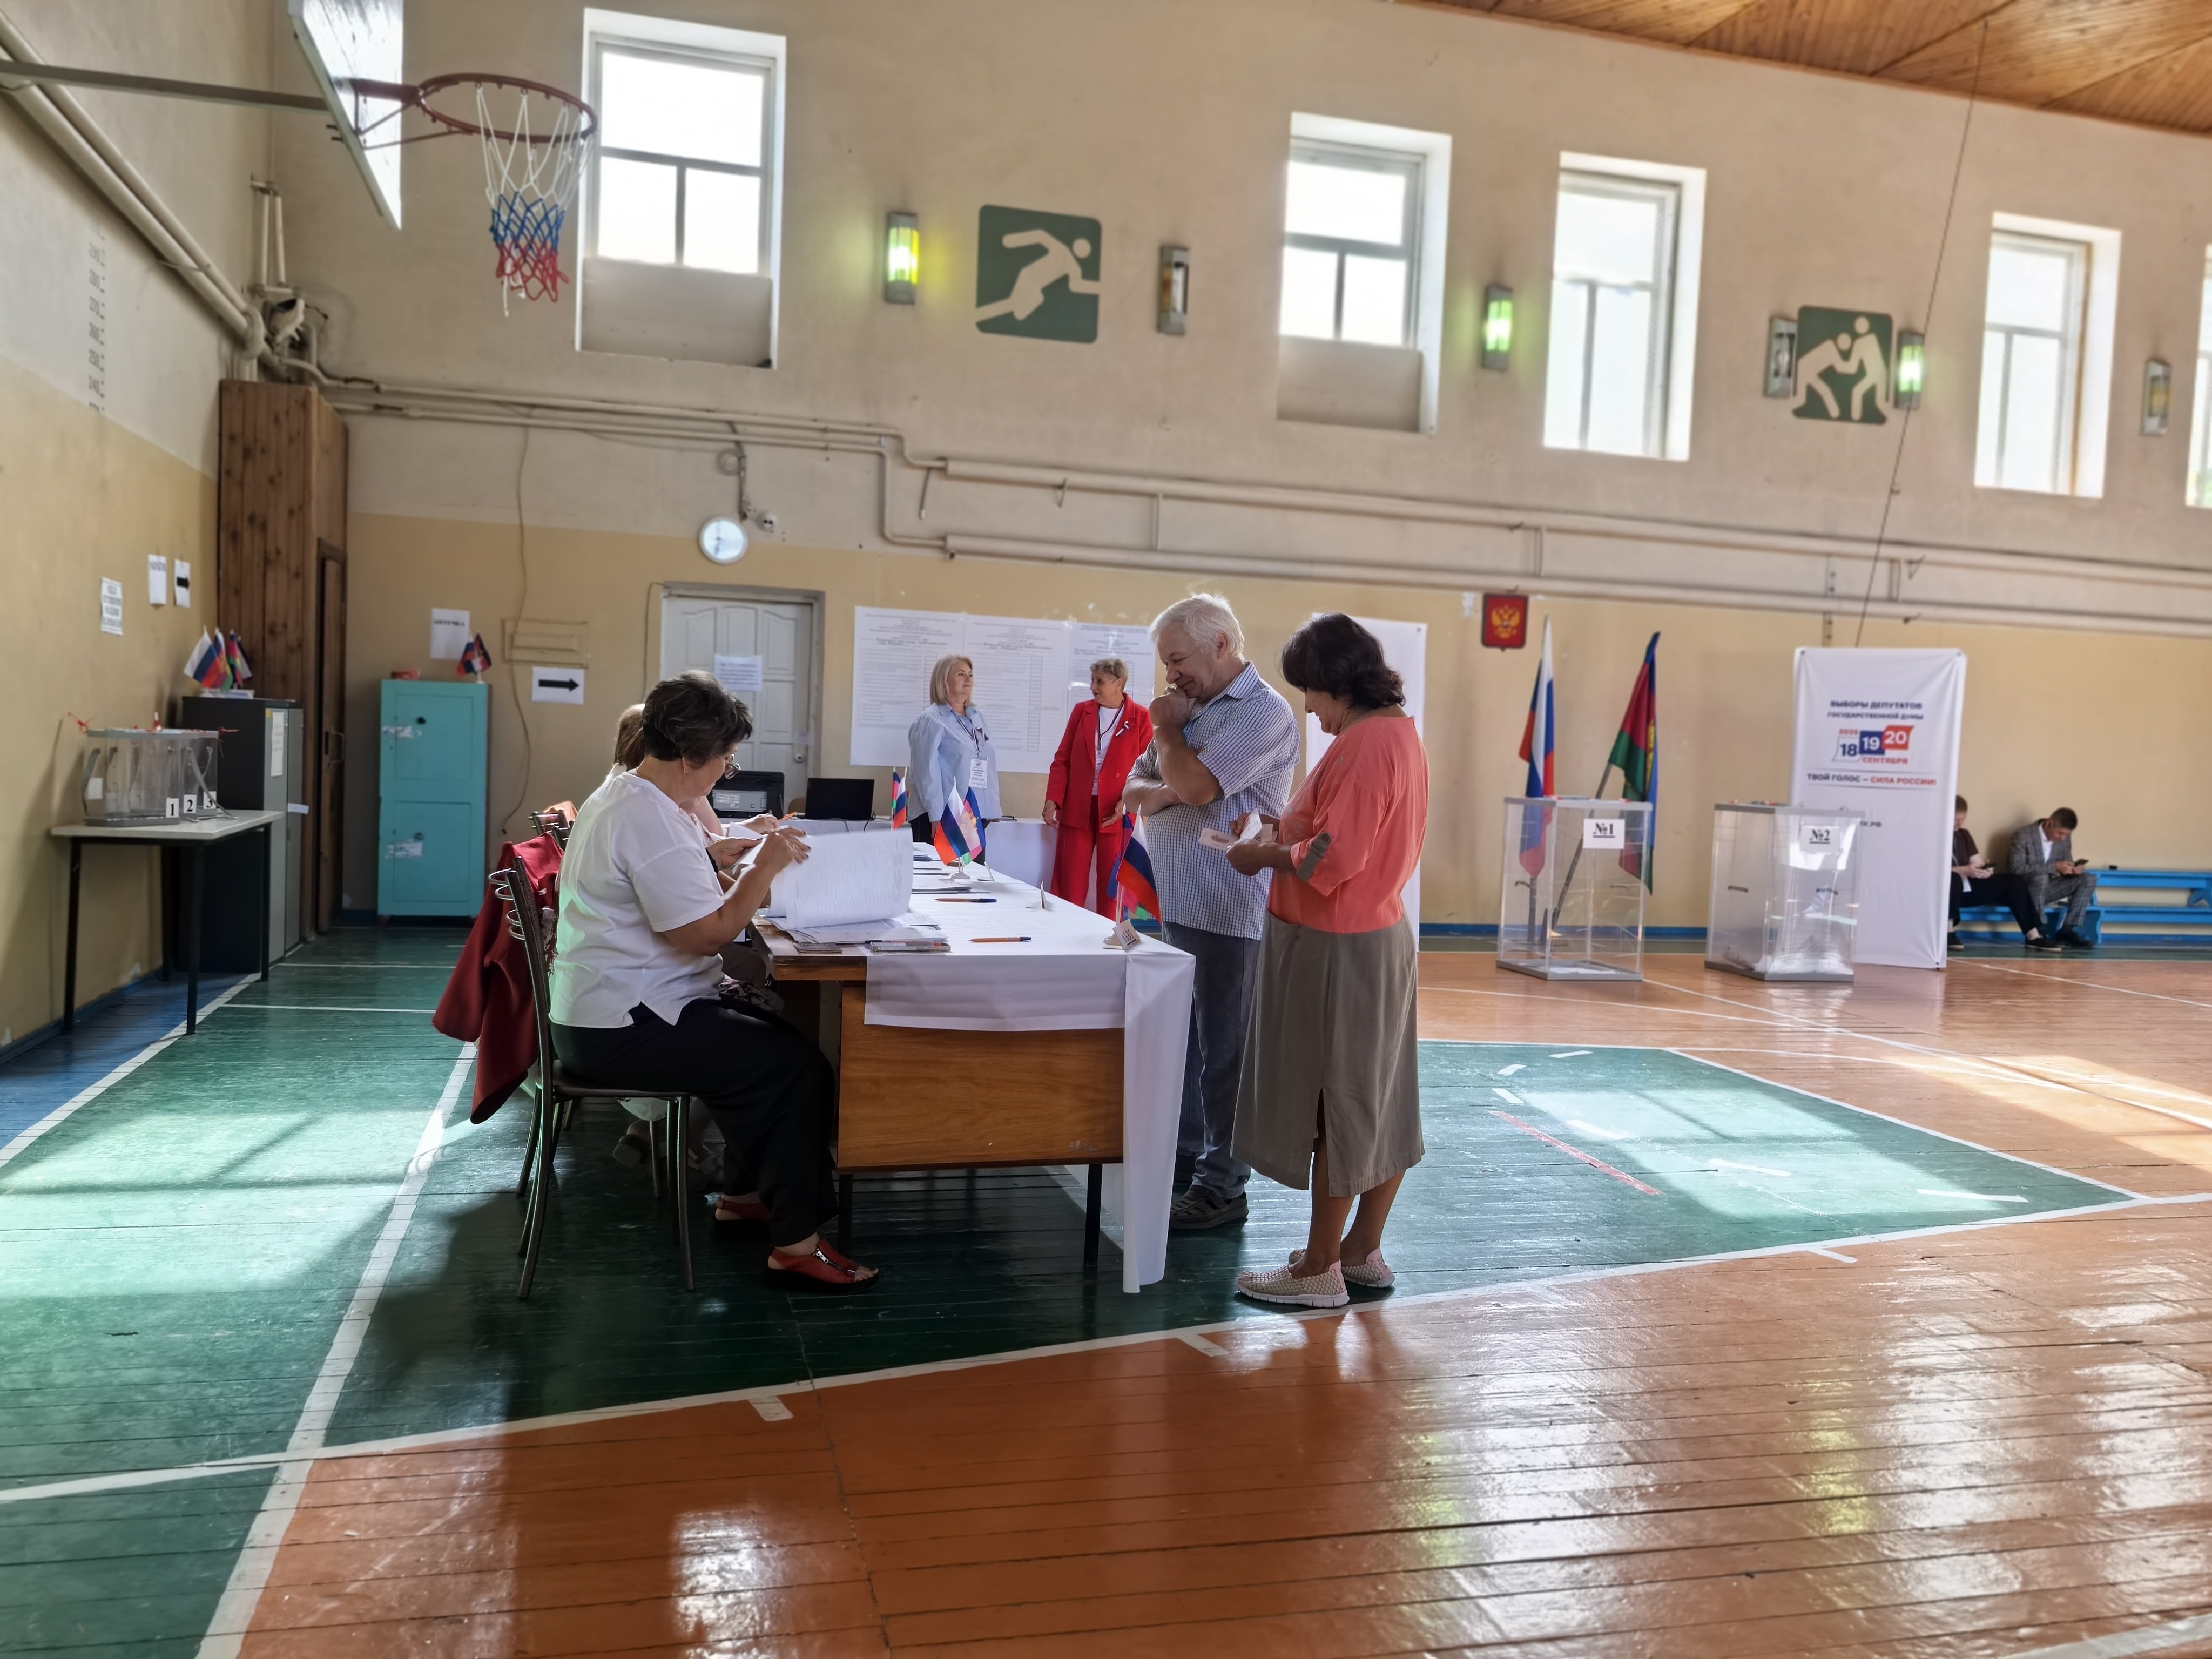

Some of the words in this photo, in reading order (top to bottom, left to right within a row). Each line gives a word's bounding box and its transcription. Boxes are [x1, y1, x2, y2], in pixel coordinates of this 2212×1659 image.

[1830, 700, 1869, 709] ВЫБОРЫ
[1870, 702, 1923, 710] ДЕПУТАТОВ
[1827, 711, 1899, 719] ГОСУДАРСТВЕННОЙ
[1862, 737, 1880, 751] 19
[1884, 731, 1907, 745] 20
[1840, 744, 1857, 757] 18
[1807, 773, 1830, 781] ТВОЙ
[1832, 774, 1861, 783] ГОЛОС
[170, 803, 174, 817] 1
[187, 799, 193, 812] 2
[1593, 822, 1613, 835] №1
[1809, 829, 1830, 841] №2
